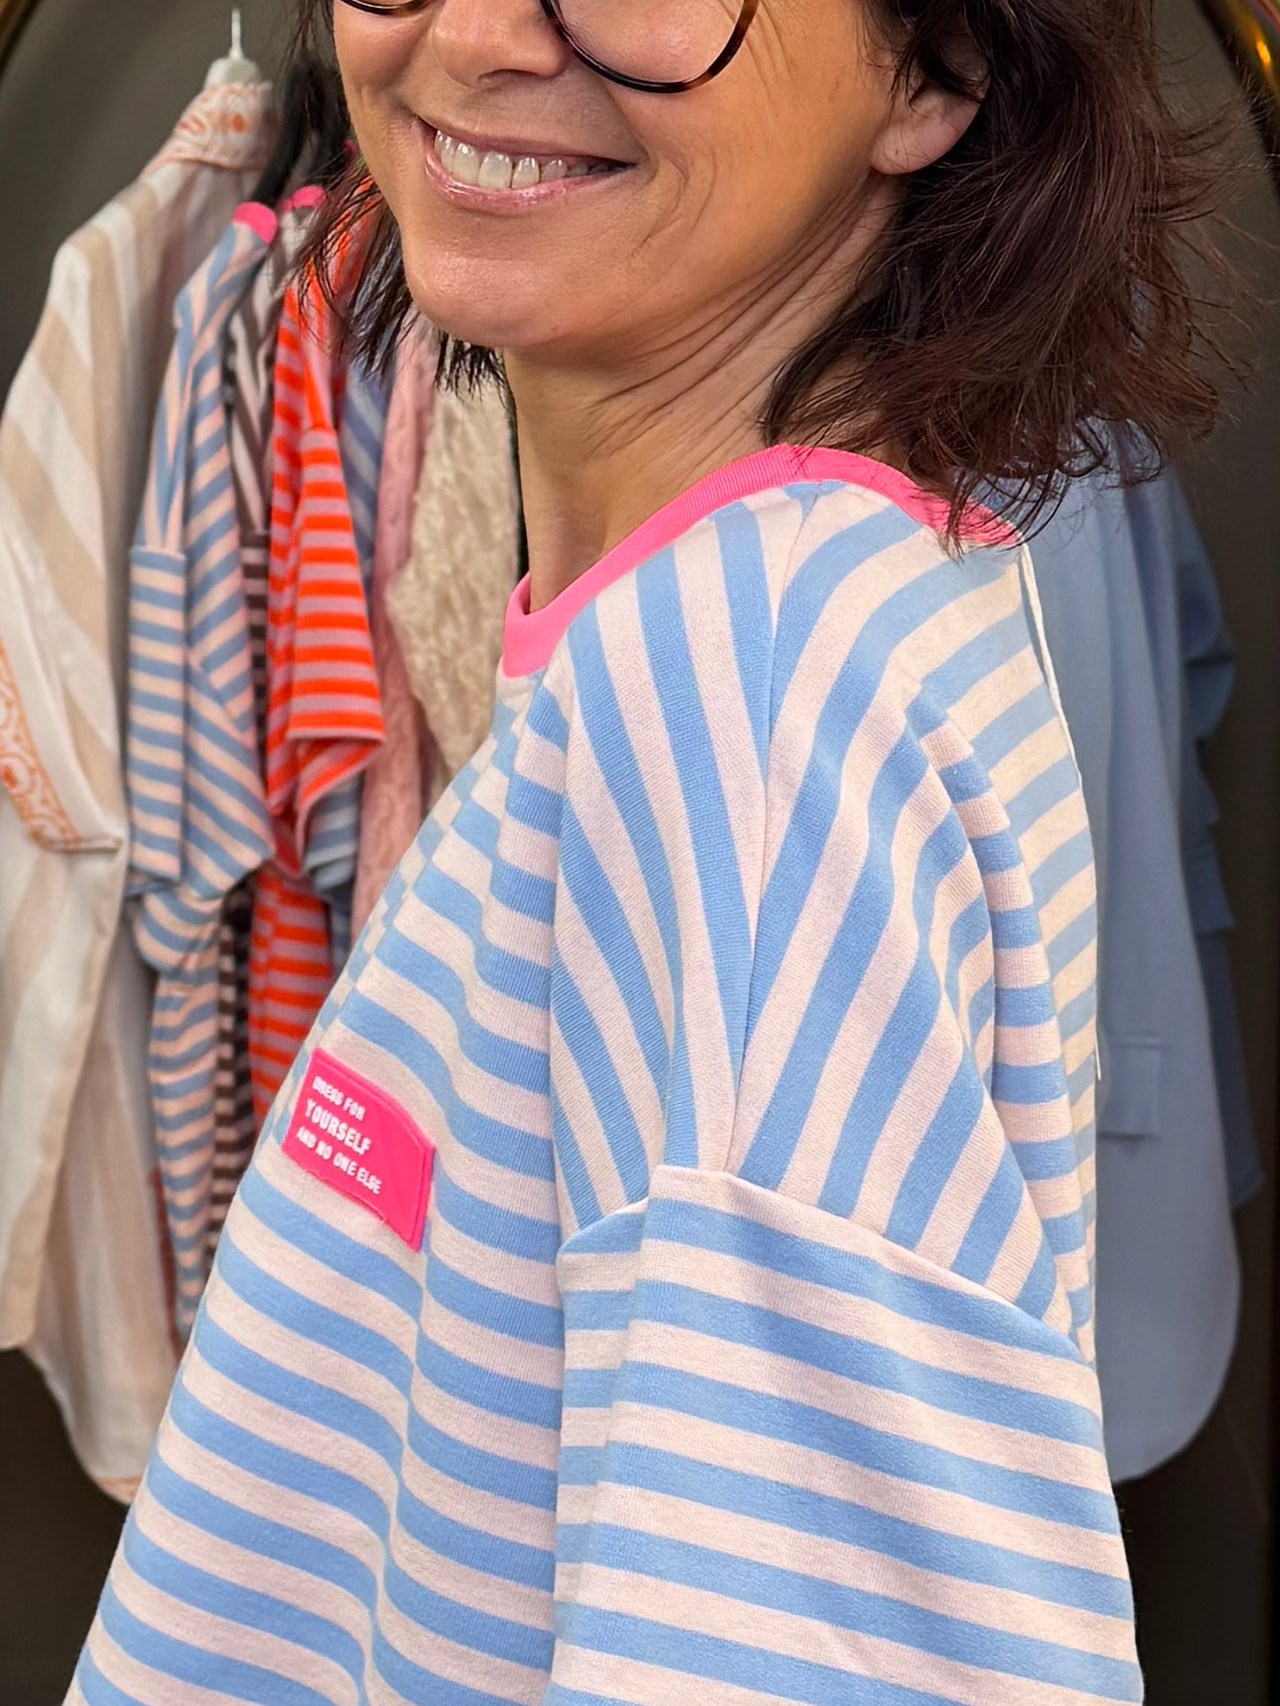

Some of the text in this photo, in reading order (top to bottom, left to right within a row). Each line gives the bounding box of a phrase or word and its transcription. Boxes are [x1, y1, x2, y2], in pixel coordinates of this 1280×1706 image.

[305, 1098, 371, 1155] YOURSELF
[343, 1097, 365, 1121] FOR
[316, 1140, 333, 1160] NO
[333, 1152, 357, 1176] ONE
[356, 1167, 381, 1194] ELSE
